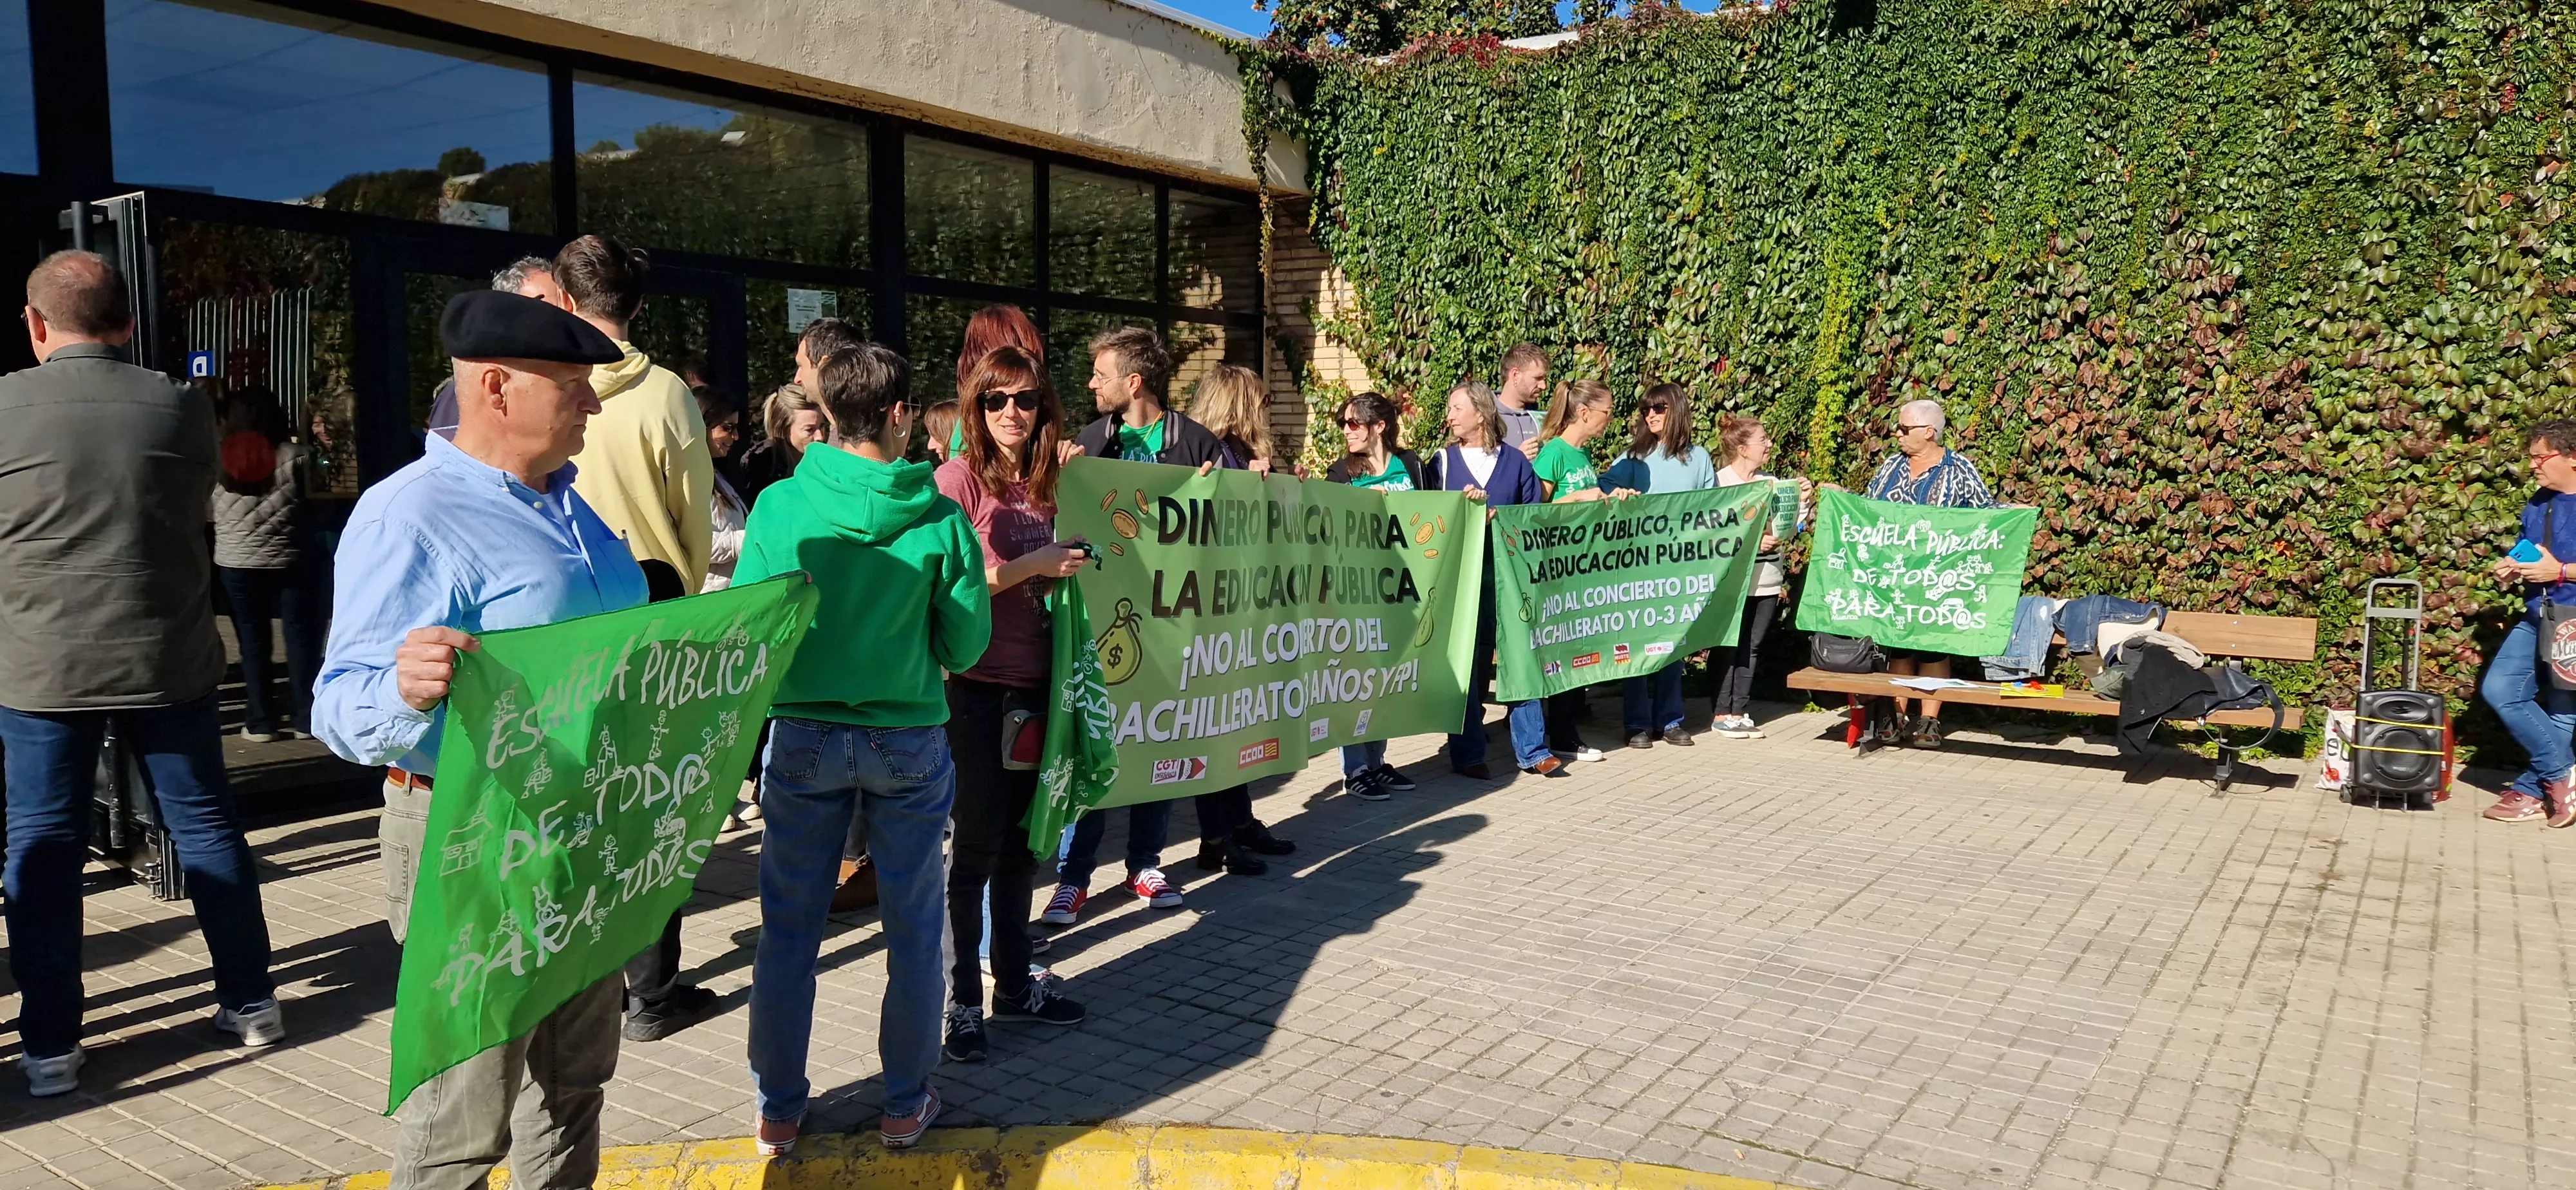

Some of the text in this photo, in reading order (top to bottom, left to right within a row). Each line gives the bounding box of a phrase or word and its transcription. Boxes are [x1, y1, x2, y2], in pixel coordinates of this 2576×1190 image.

[1157, 496, 1262, 547] DINERO
[1345, 509, 1409, 550] PARA
[1521, 507, 1741, 552] DINERO PÚBLICO, PARA
[1841, 522, 1917, 551] ESCUELA
[1527, 562, 1548, 584] LA
[1549, 541, 1649, 581] EDUCACIÓN
[1852, 567, 1977, 592] DE TOD@S
[1151, 569, 1202, 618] LA
[1318, 552, 1421, 605] PÚBLICA
[1564, 590, 1582, 612] AL
[1583, 577, 1681, 609] CONCIERTO
[1530, 611, 1625, 650] BACHILLERATO
[1627, 609, 1641, 629] Y
[1643, 605, 1675, 627] 0-3
[1832, 598, 1987, 630] PARA TOD@S
[1179, 632, 1233, 691] ¡NO
[1235, 627, 1257, 671] AL
[1356, 618, 1389, 653] DEL
[1310, 658, 1377, 706] AÑOS
[1379, 667, 1396, 699] Y
[1388, 658, 1419, 695] FP!
[1156, 759, 1178, 771] CGT
[1239, 744, 1264, 765] CCOO
[500, 800, 568, 880] DE
